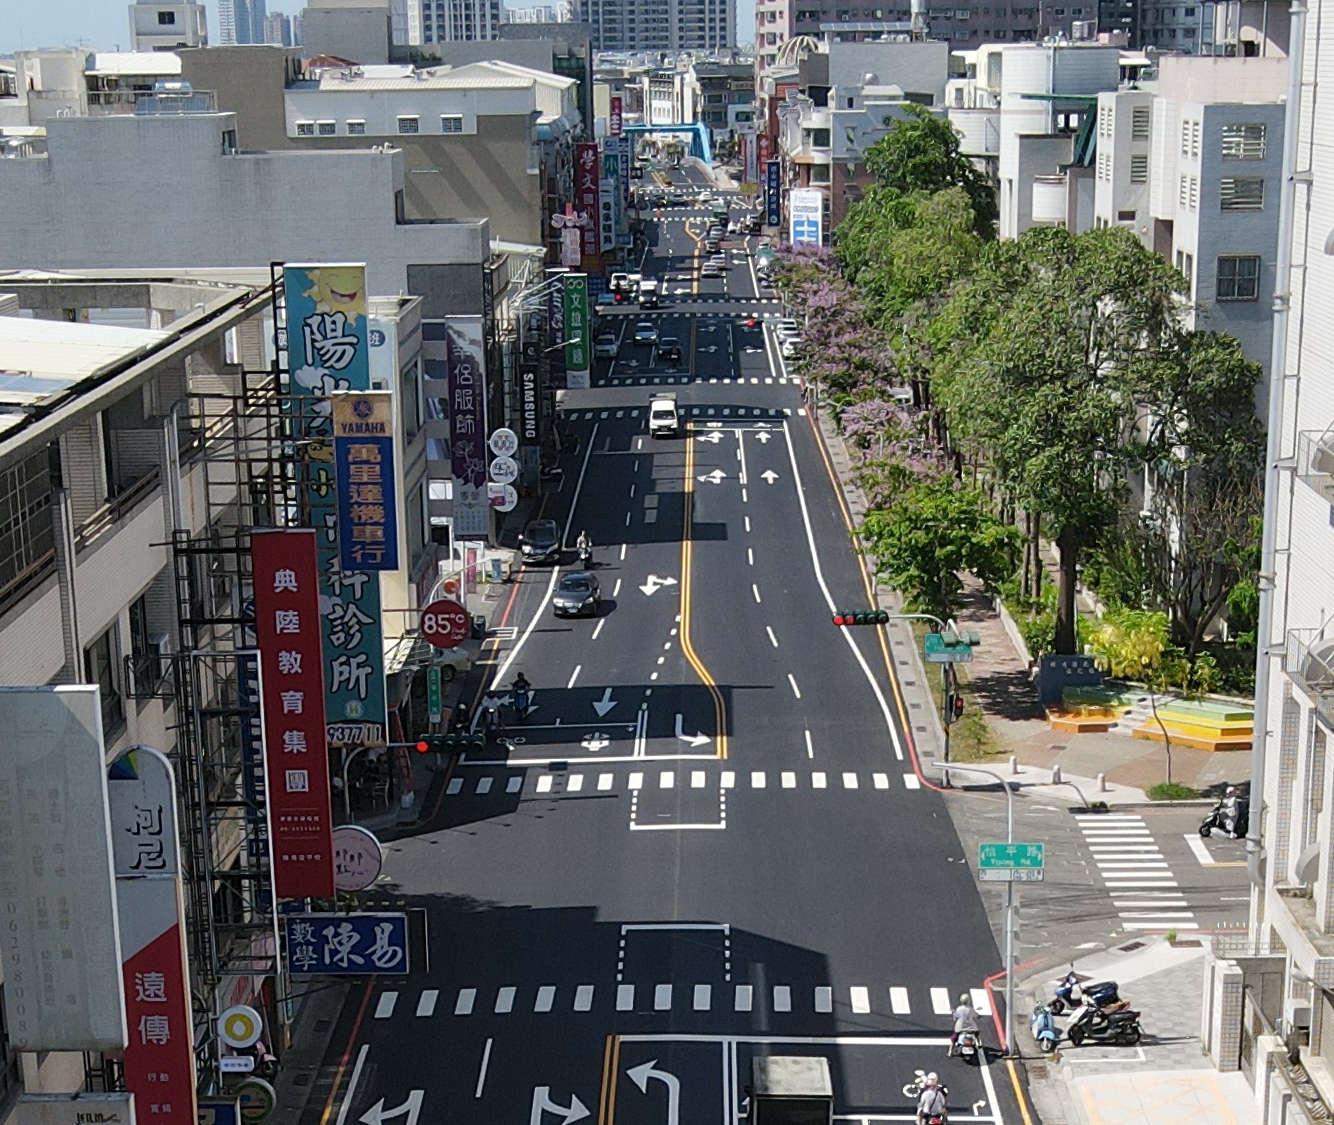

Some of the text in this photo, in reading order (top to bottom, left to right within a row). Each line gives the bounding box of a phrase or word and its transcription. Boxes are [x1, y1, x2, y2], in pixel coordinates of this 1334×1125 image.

[341, 422, 386, 434] YAMAHA
[524, 372, 536, 438] SAMSUNG
[347, 444, 386, 564] 萬里達機車行
[290, 919, 318, 972] 數學
[322, 921, 403, 969] 陳易
[134, 971, 171, 1046] 遠傳
